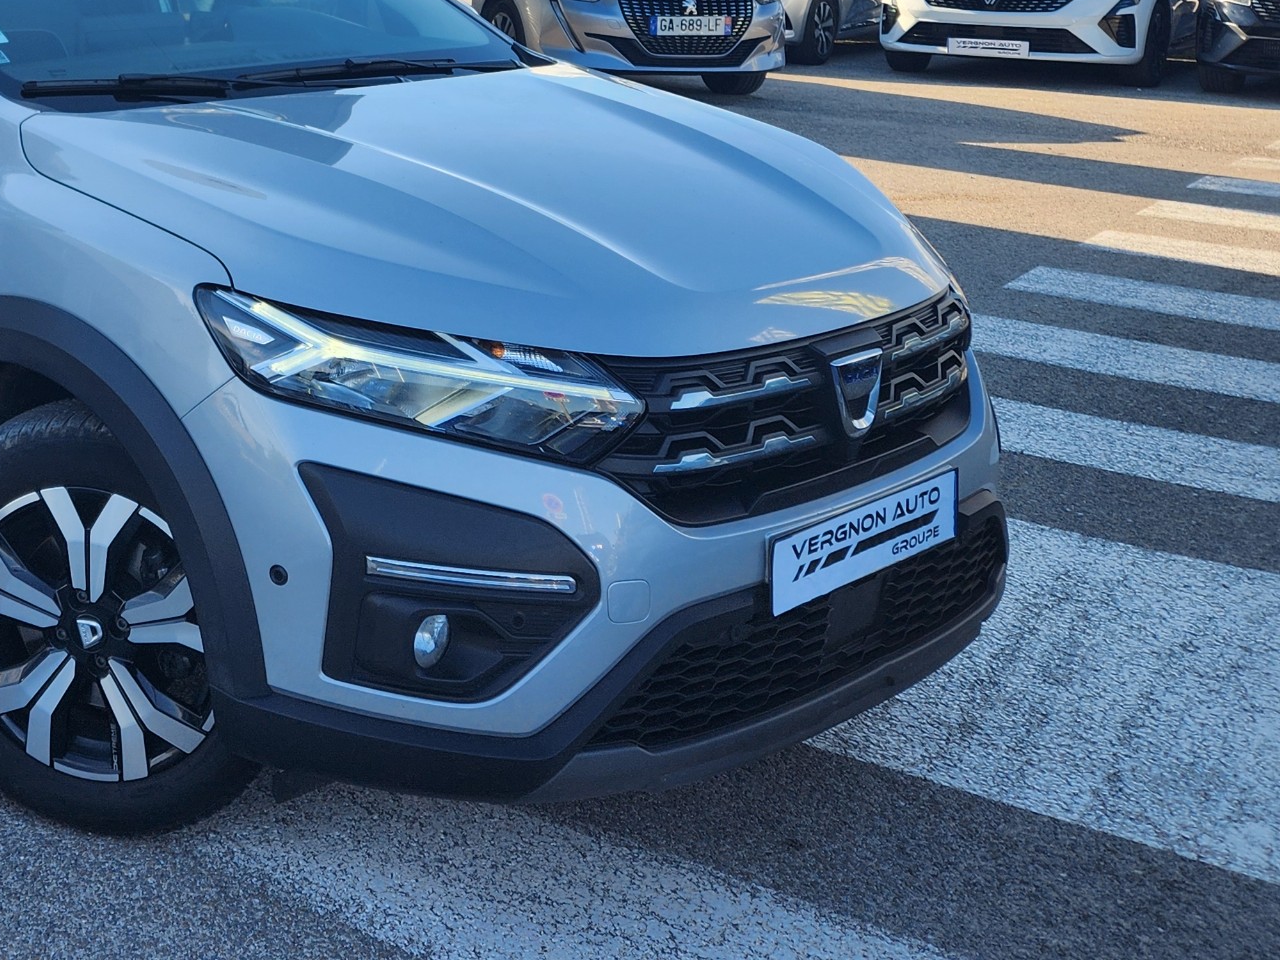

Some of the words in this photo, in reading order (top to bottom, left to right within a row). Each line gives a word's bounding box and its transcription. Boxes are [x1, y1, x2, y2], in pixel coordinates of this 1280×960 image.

[659, 18, 722, 32] GA-689-LF
[956, 39, 996, 47] VERGNON
[232, 325, 263, 341] DACIA
[791, 507, 888, 561] VERGNON
[892, 486, 941, 522] AUTO
[891, 524, 941, 556] GROUPE
